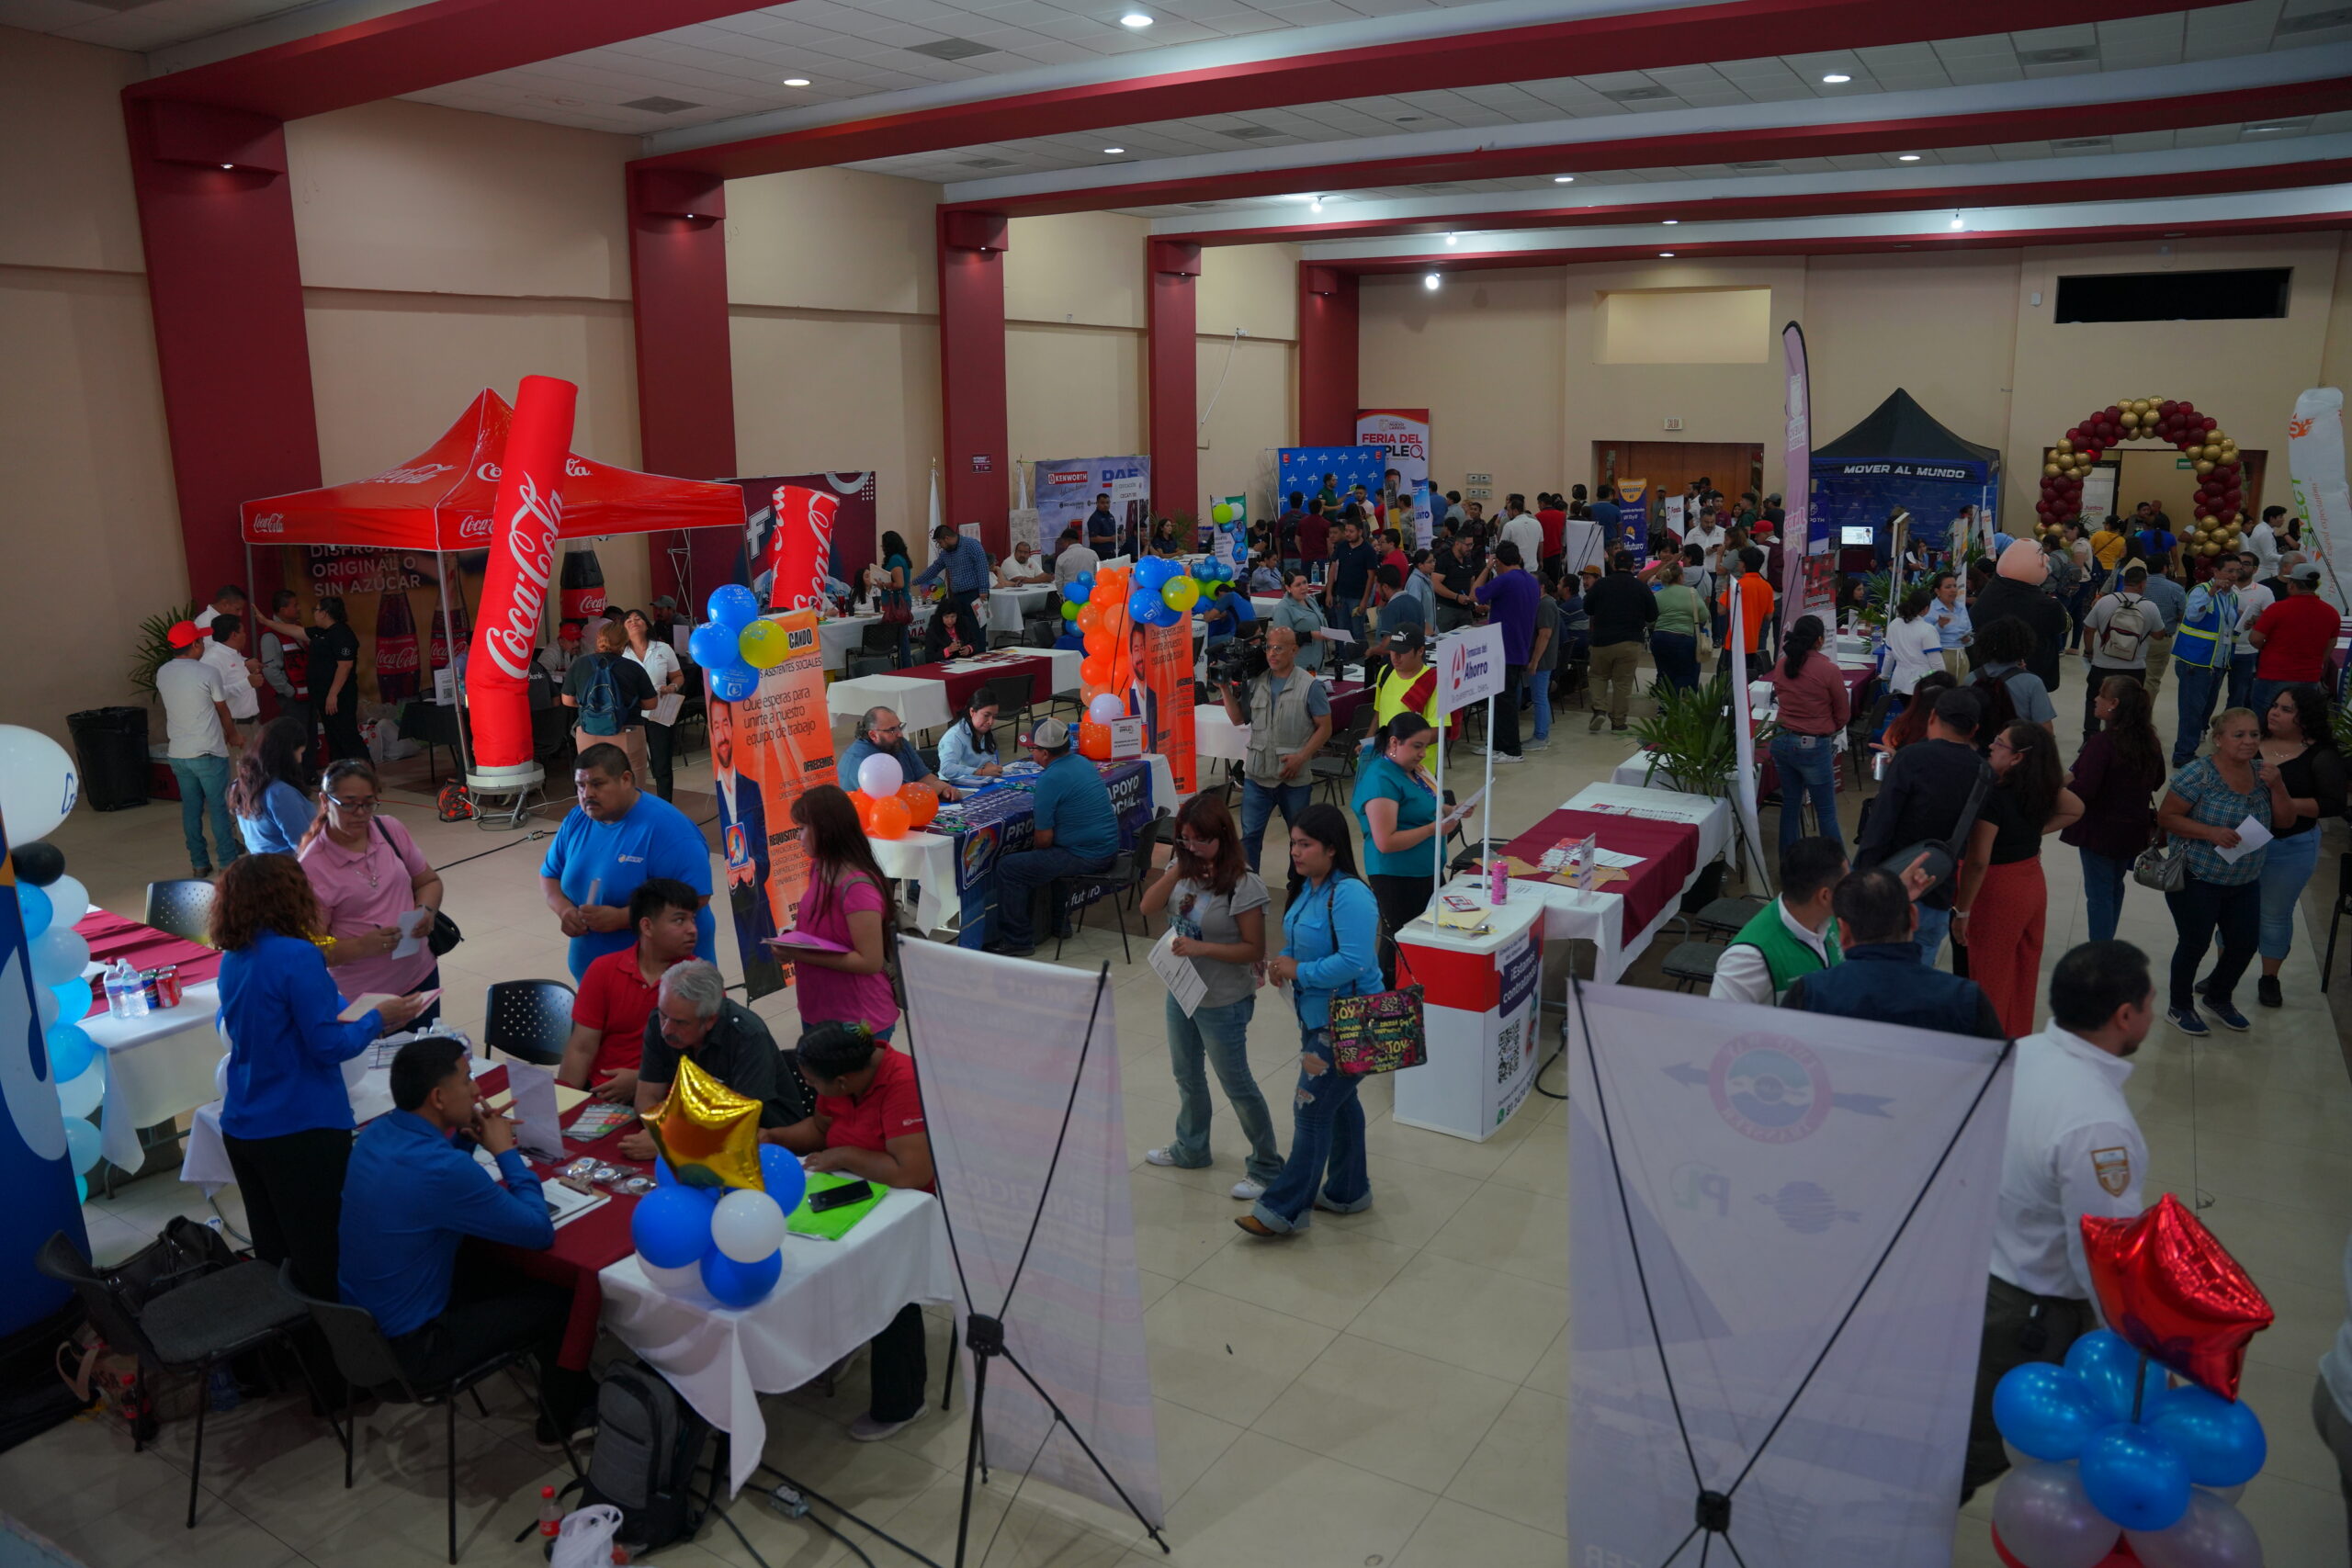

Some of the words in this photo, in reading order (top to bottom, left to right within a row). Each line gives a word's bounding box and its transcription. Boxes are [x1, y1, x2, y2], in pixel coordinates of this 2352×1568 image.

[1667, 418, 1679, 429] SALIDA
[1362, 433, 1396, 444] FERIA
[1399, 433, 1422, 444] DEL
[1384, 445, 1425, 461] PLEO
[1055, 473, 1088, 482] KENWORTH
[1844, 464, 1891, 475] MOVER
[1894, 466, 1912, 475] AL
[1917, 467, 1966, 479] MUNDO
[312, 557, 398, 578] ORIGINAL
[403, 556, 416, 570] O
[314, 582, 344, 597] SIN
[349, 573, 422, 593] AZÚCAR
[788, 628, 813, 649] CANDO
[763, 661, 796, 678] ASISTENTES
[796, 657, 823, 671] SOCIALES
[1464, 660, 1488, 682] Ahorro
[742, 698, 763, 712] Que
[763, 692, 791, 710] esperas
[792, 687, 810, 704] para
[744, 713, 767, 729] unirte
[769, 713, 775, 724] a
[776, 705, 806, 721] nuestro
[746, 728, 775, 748] equipo
[775, 725, 786, 739] de
[787, 718, 816, 736] trabajo
